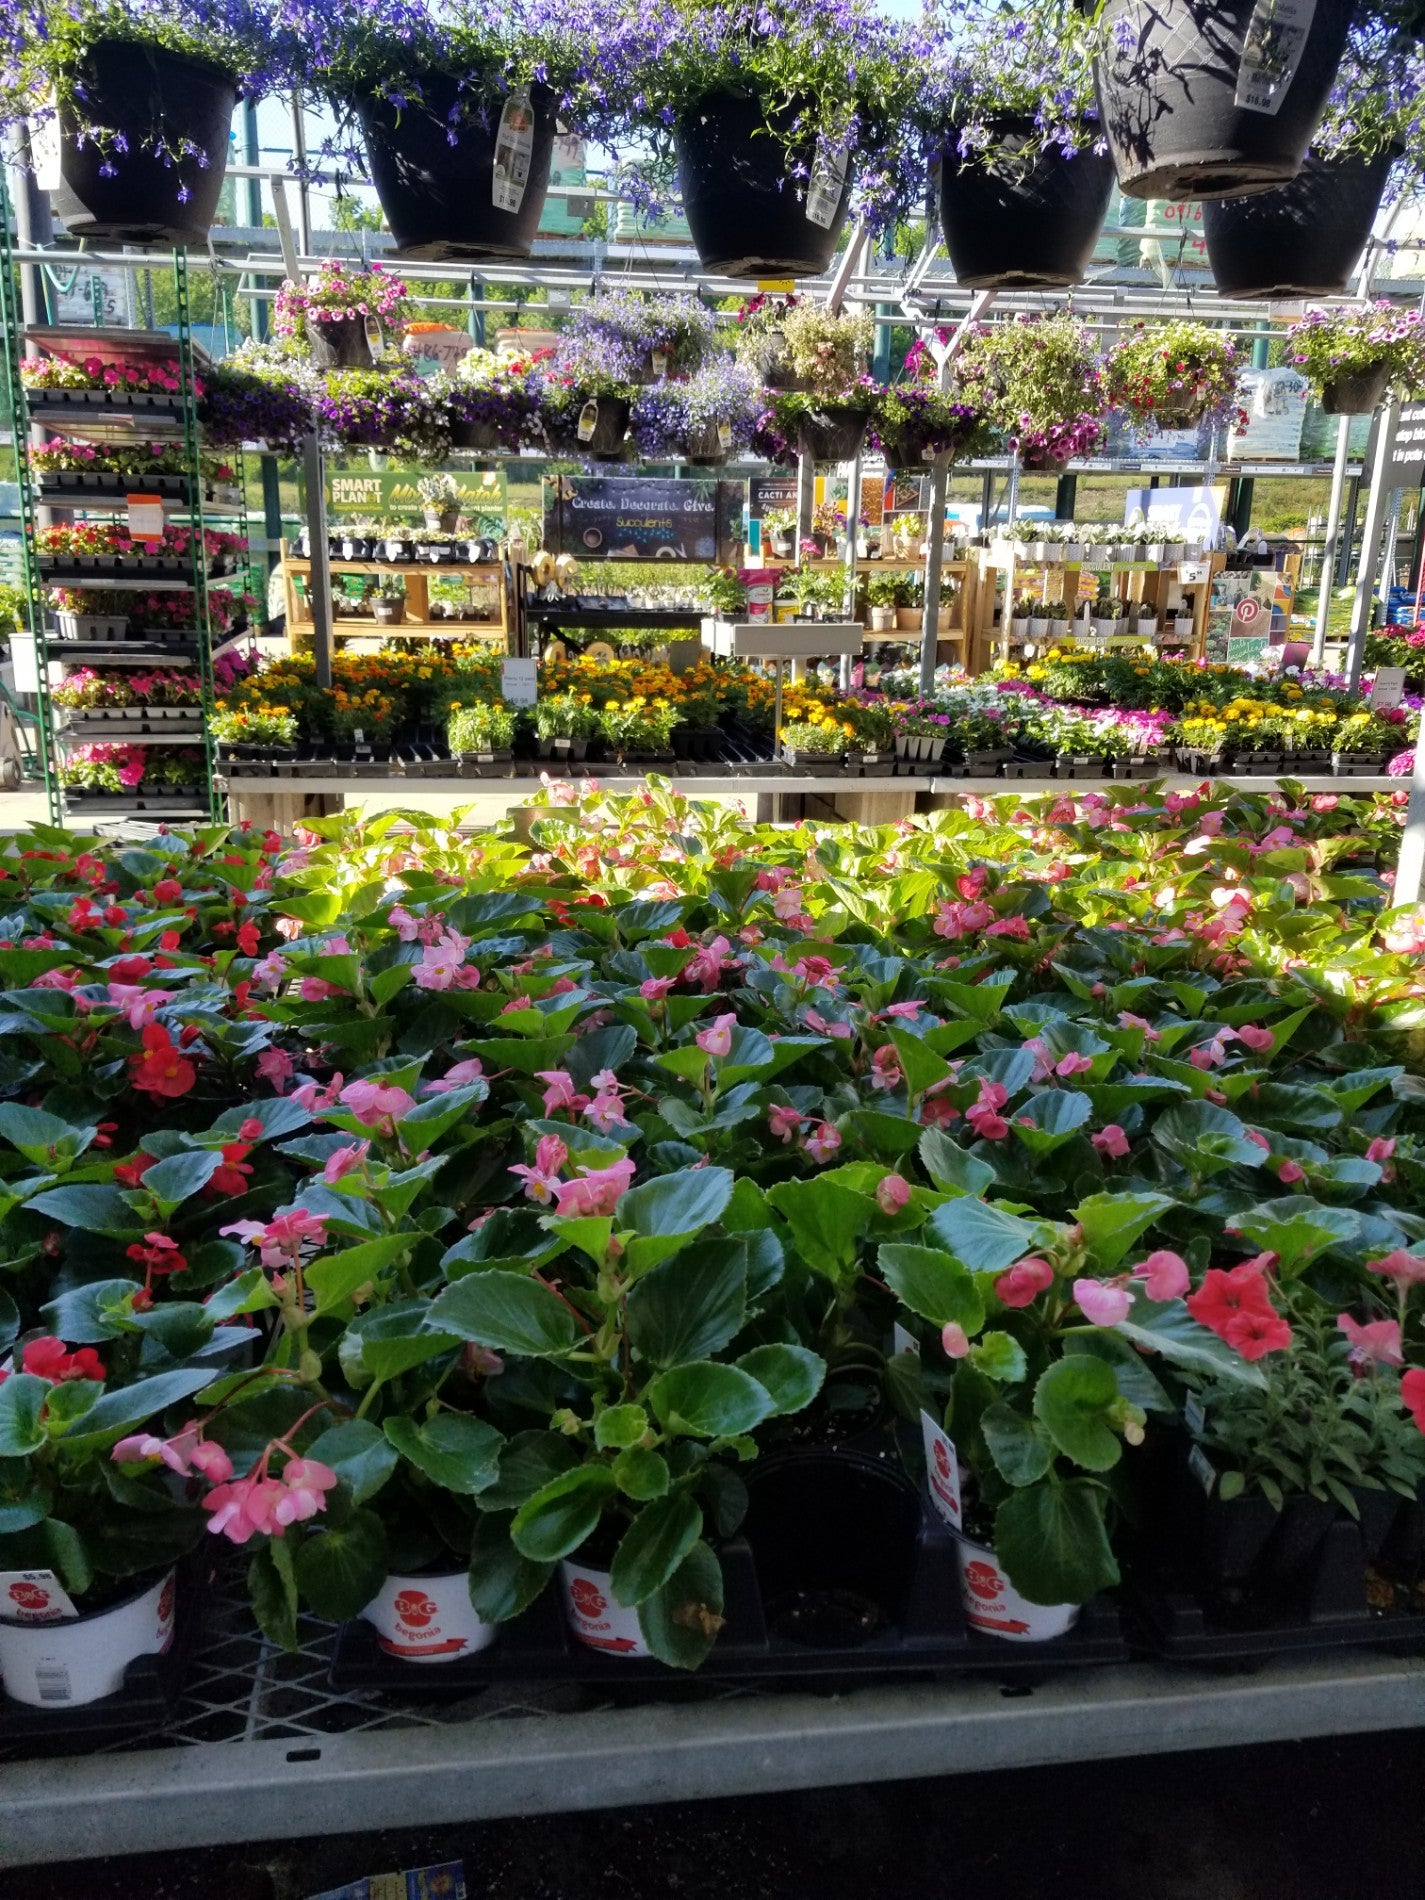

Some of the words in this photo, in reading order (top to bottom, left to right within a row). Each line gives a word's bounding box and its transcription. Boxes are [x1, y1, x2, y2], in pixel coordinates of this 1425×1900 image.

[332, 479, 381, 492] SMART
[758, 491, 783, 499] CACTI
[572, 497, 616, 510] Create.
[621, 498, 679, 511] Decorate.
[616, 516, 673, 529] Succulents
[394, 1622, 441, 1641] begonia
